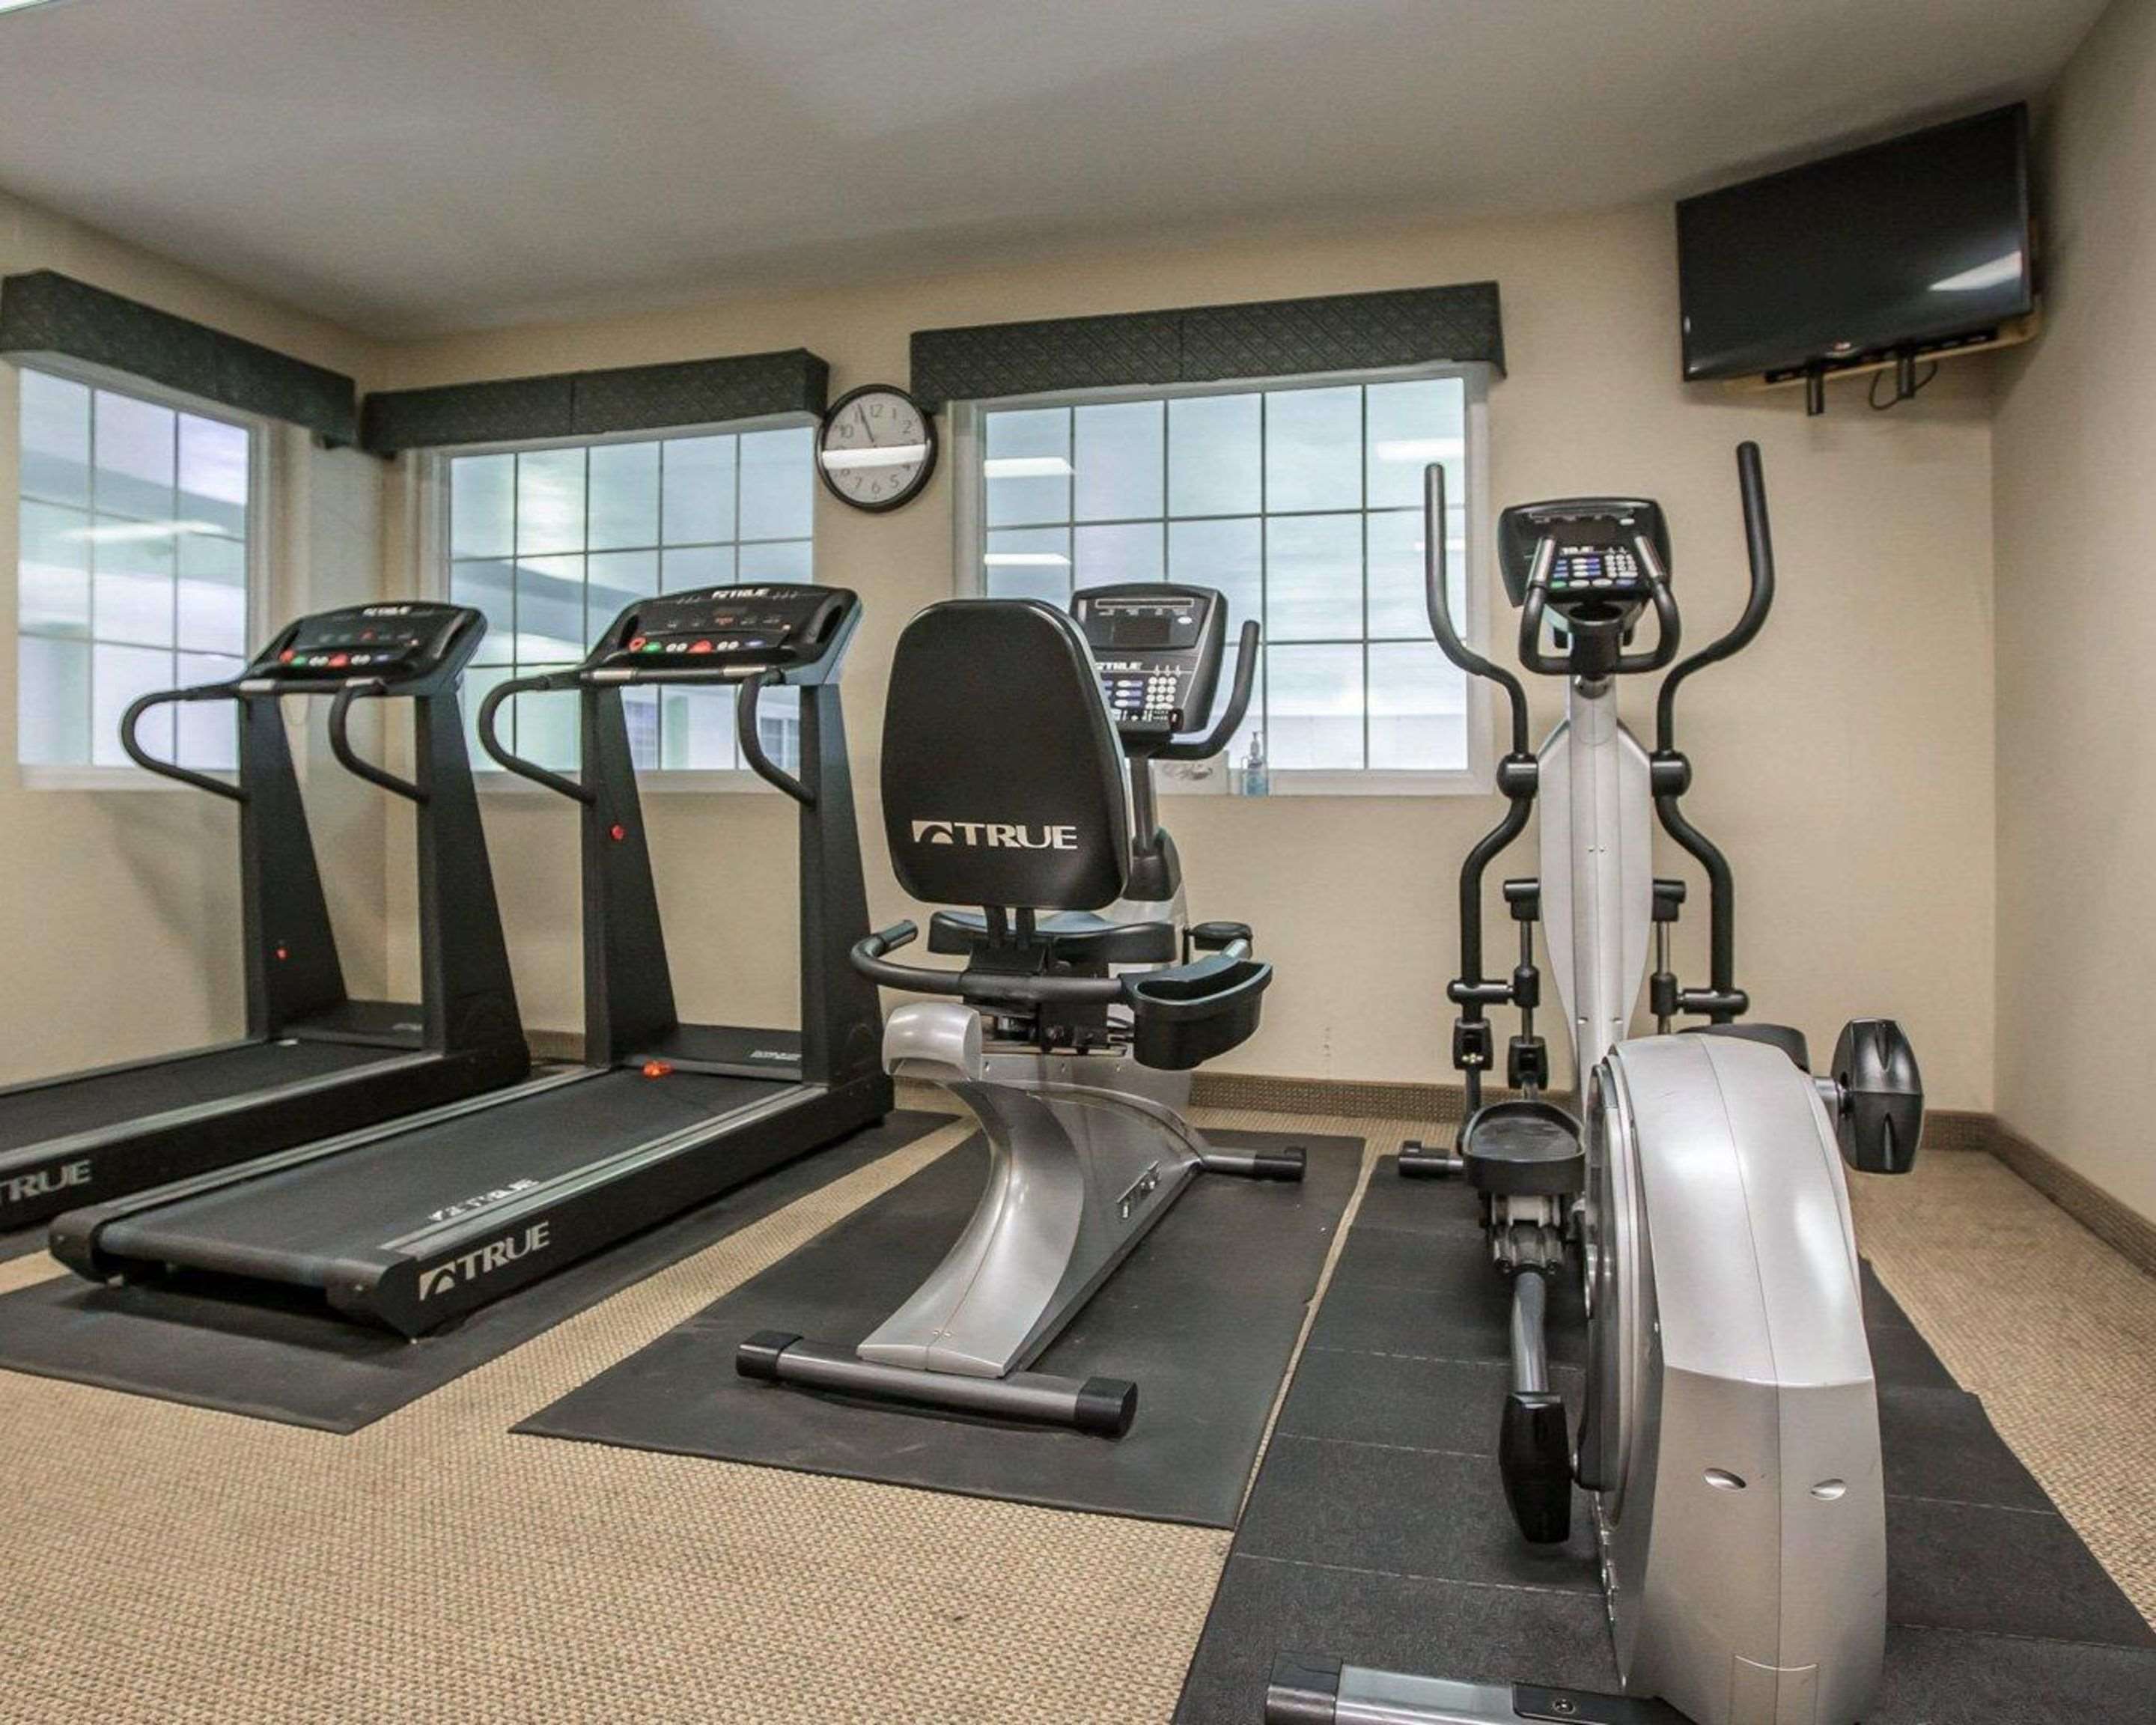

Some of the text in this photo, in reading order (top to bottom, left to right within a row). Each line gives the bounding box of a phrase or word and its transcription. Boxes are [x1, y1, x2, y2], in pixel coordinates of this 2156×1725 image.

[870, 404, 884, 418] 12
[839, 424, 855, 439] 10
[902, 420, 912, 434] 2
[854, 475, 863, 489] 7
[871, 482, 880, 494] 6
[890, 473, 900, 489] 5
[954, 821, 1078, 850] TRUE
[456, 1220, 549, 1280] TRUE
